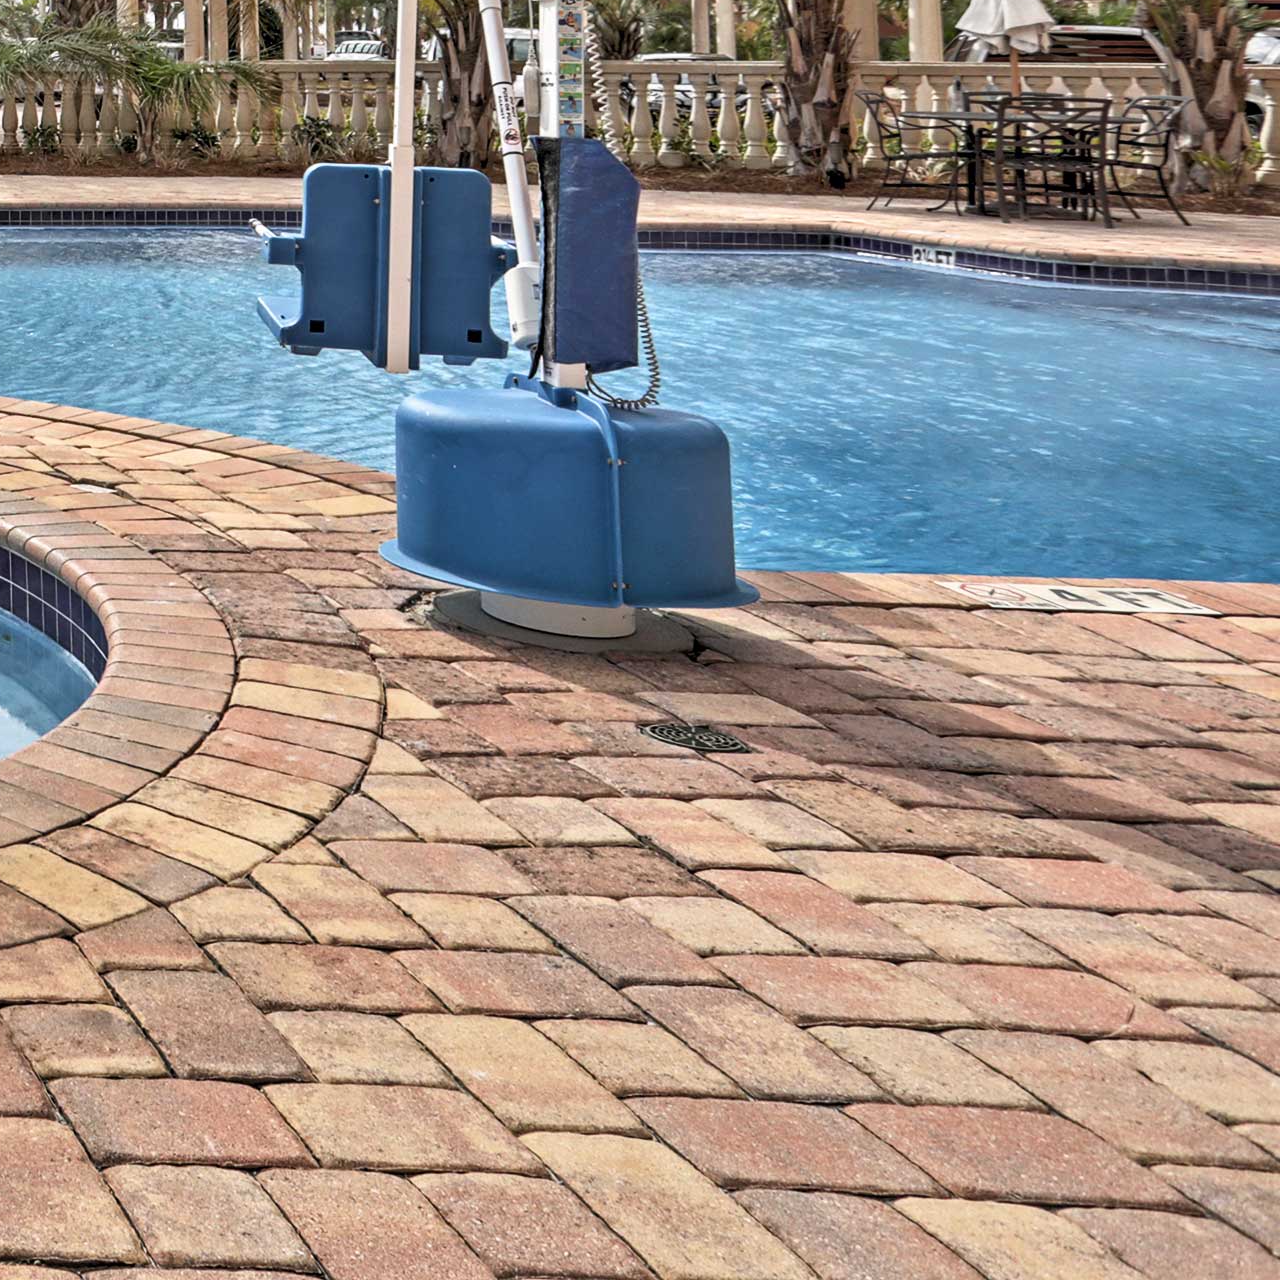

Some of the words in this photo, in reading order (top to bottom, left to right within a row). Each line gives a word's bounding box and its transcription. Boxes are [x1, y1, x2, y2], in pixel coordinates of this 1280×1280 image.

[505, 103, 510, 111] OR
[935, 250, 952, 265] FT
[1049, 589, 1105, 607] 4
